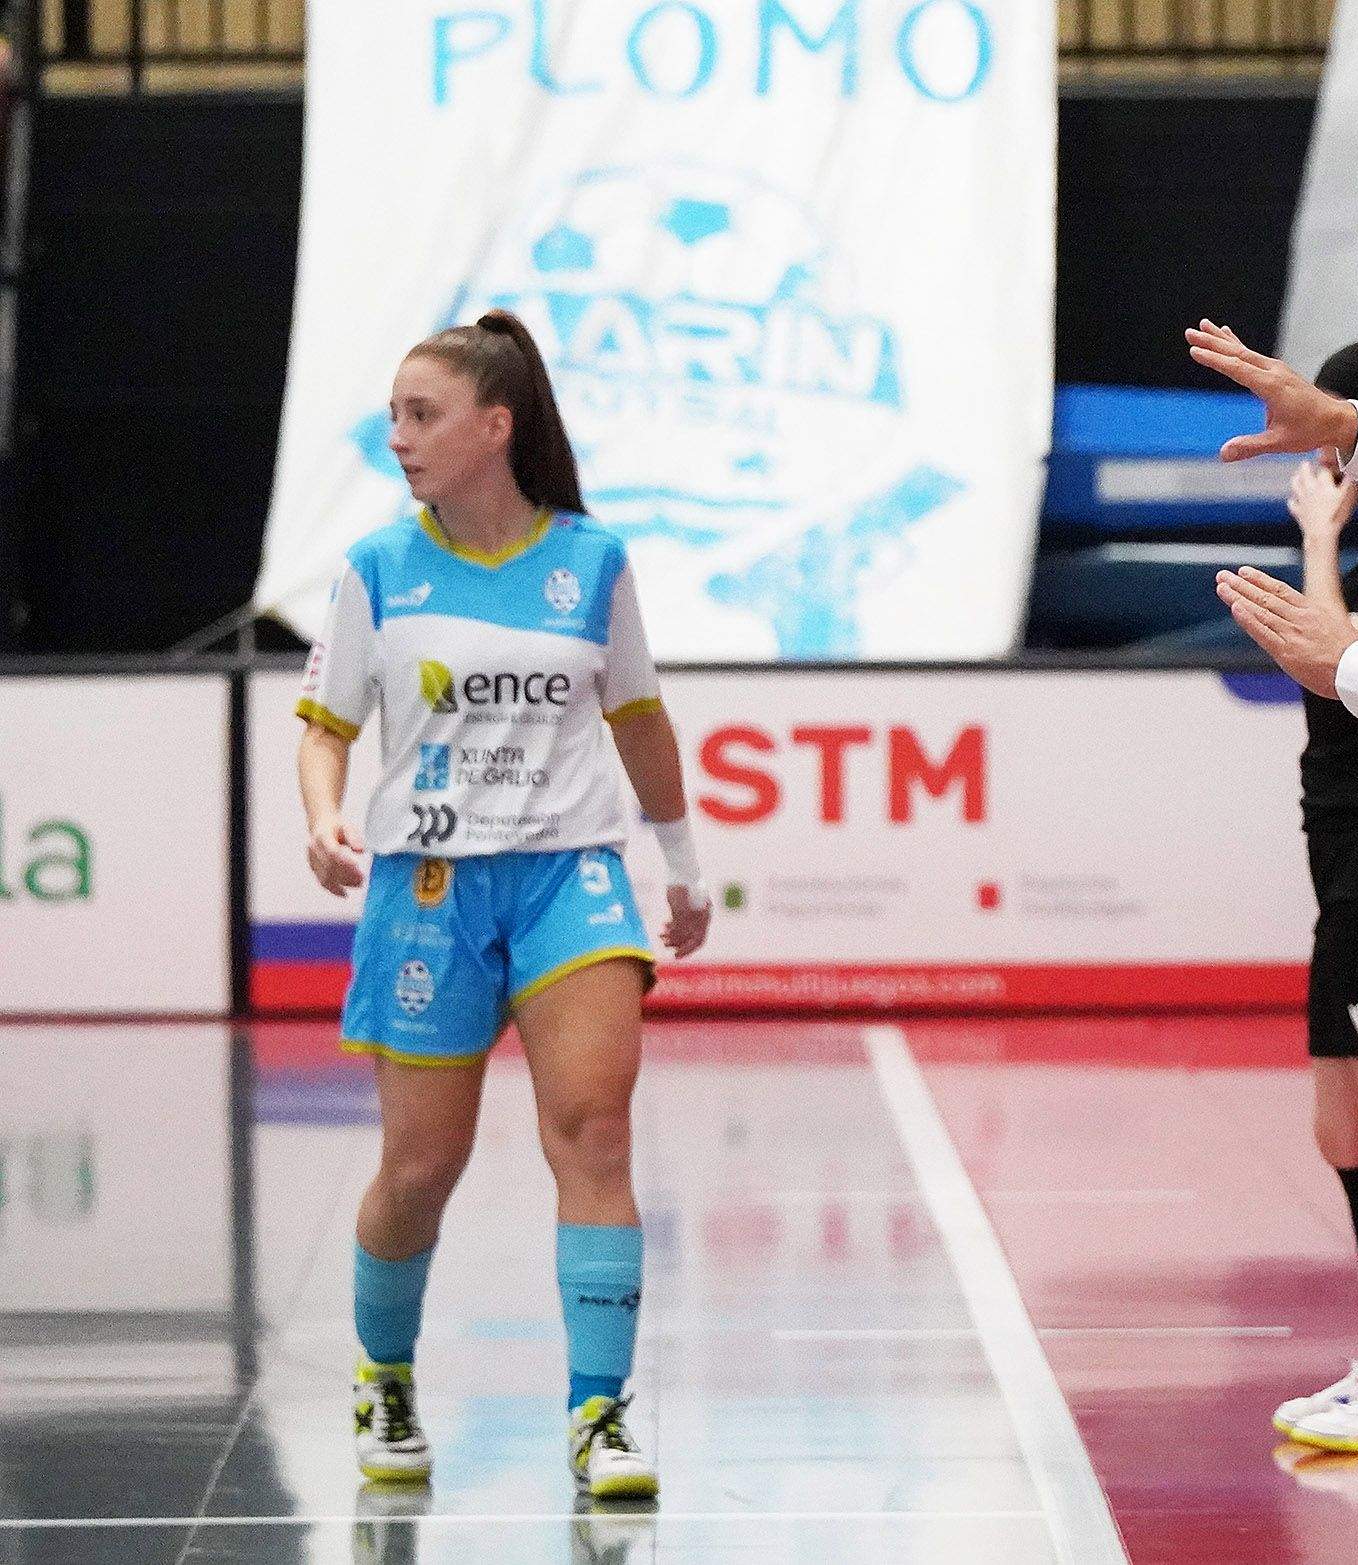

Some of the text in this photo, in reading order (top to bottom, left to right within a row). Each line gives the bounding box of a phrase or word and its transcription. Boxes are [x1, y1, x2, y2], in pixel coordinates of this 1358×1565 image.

[432, 0, 992, 106] PLOMO
[463, 671, 571, 706] ence
[697, 723, 989, 825] STM
